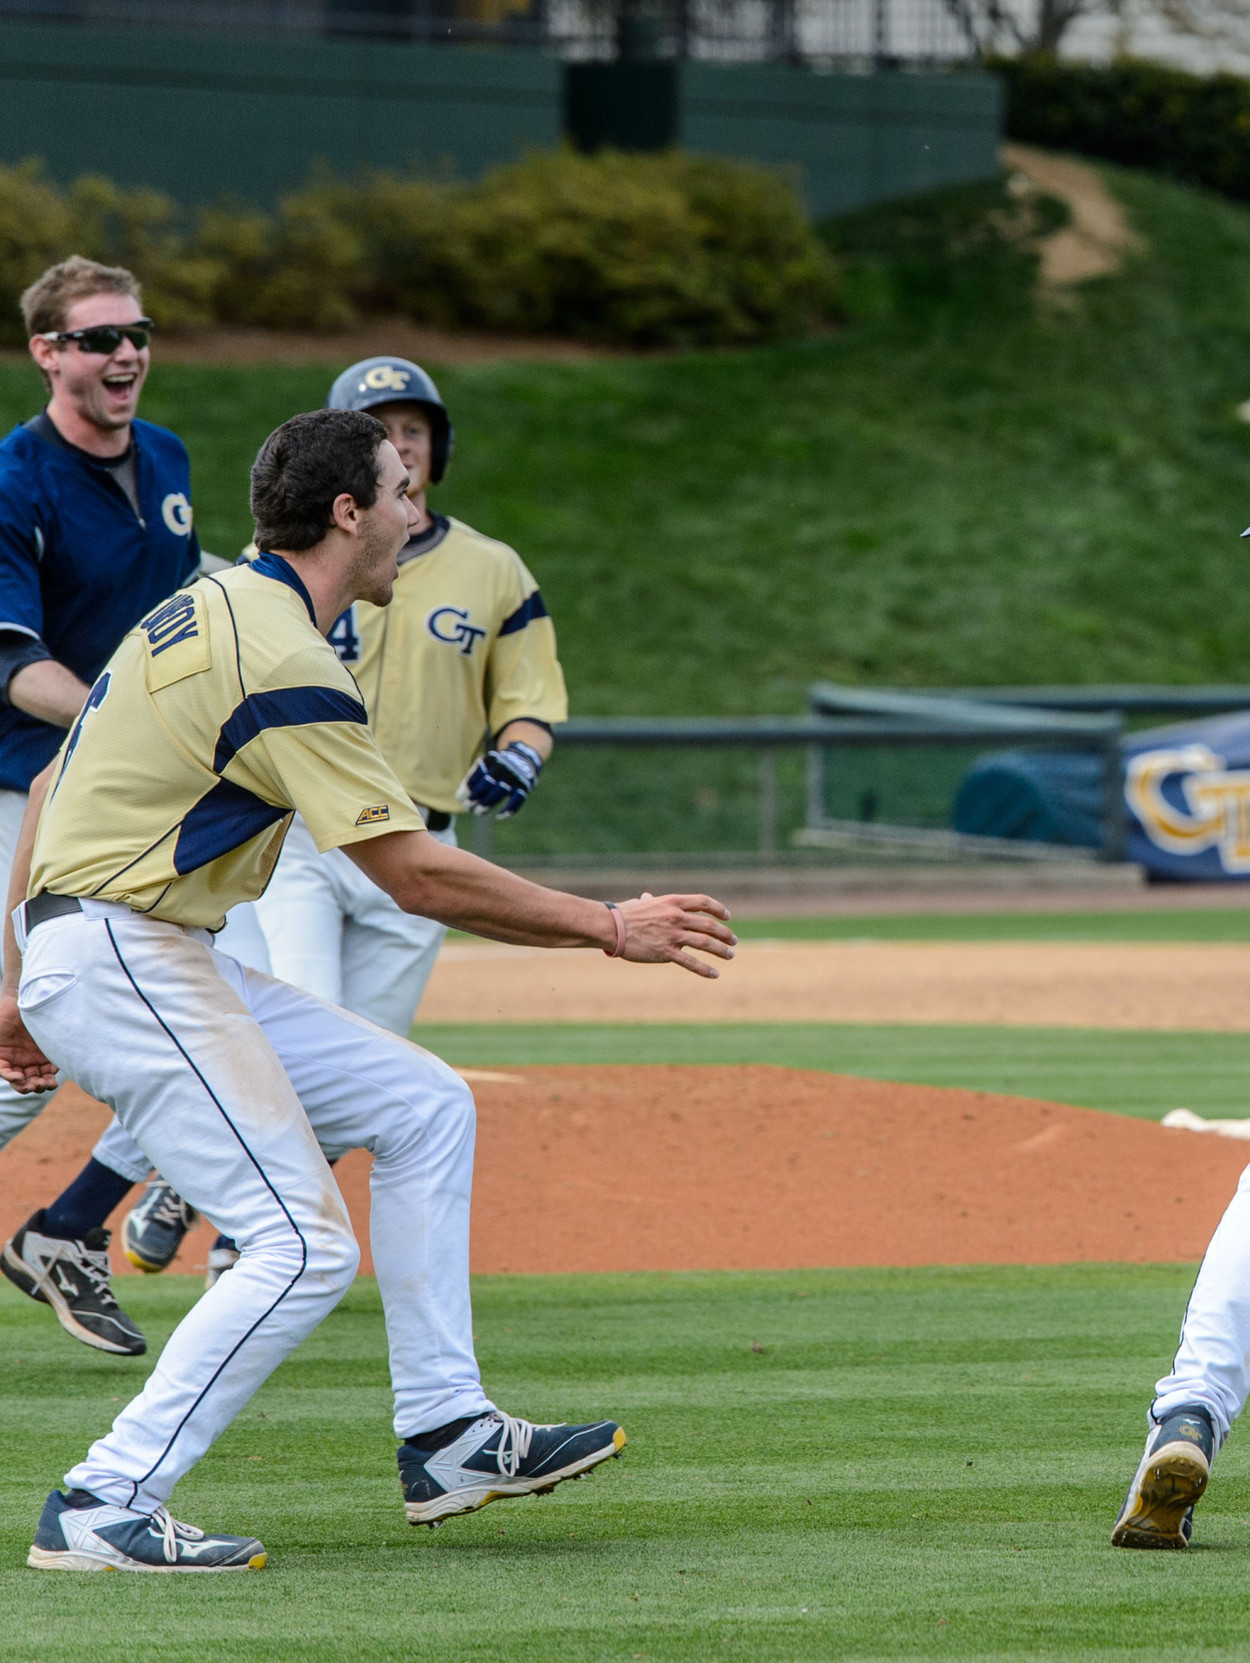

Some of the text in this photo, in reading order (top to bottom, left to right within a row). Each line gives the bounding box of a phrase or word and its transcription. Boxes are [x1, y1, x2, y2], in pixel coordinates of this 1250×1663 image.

[162, 492, 193, 540] G
[425, 603, 487, 657] GT
[358, 806, 389, 821] ACC
